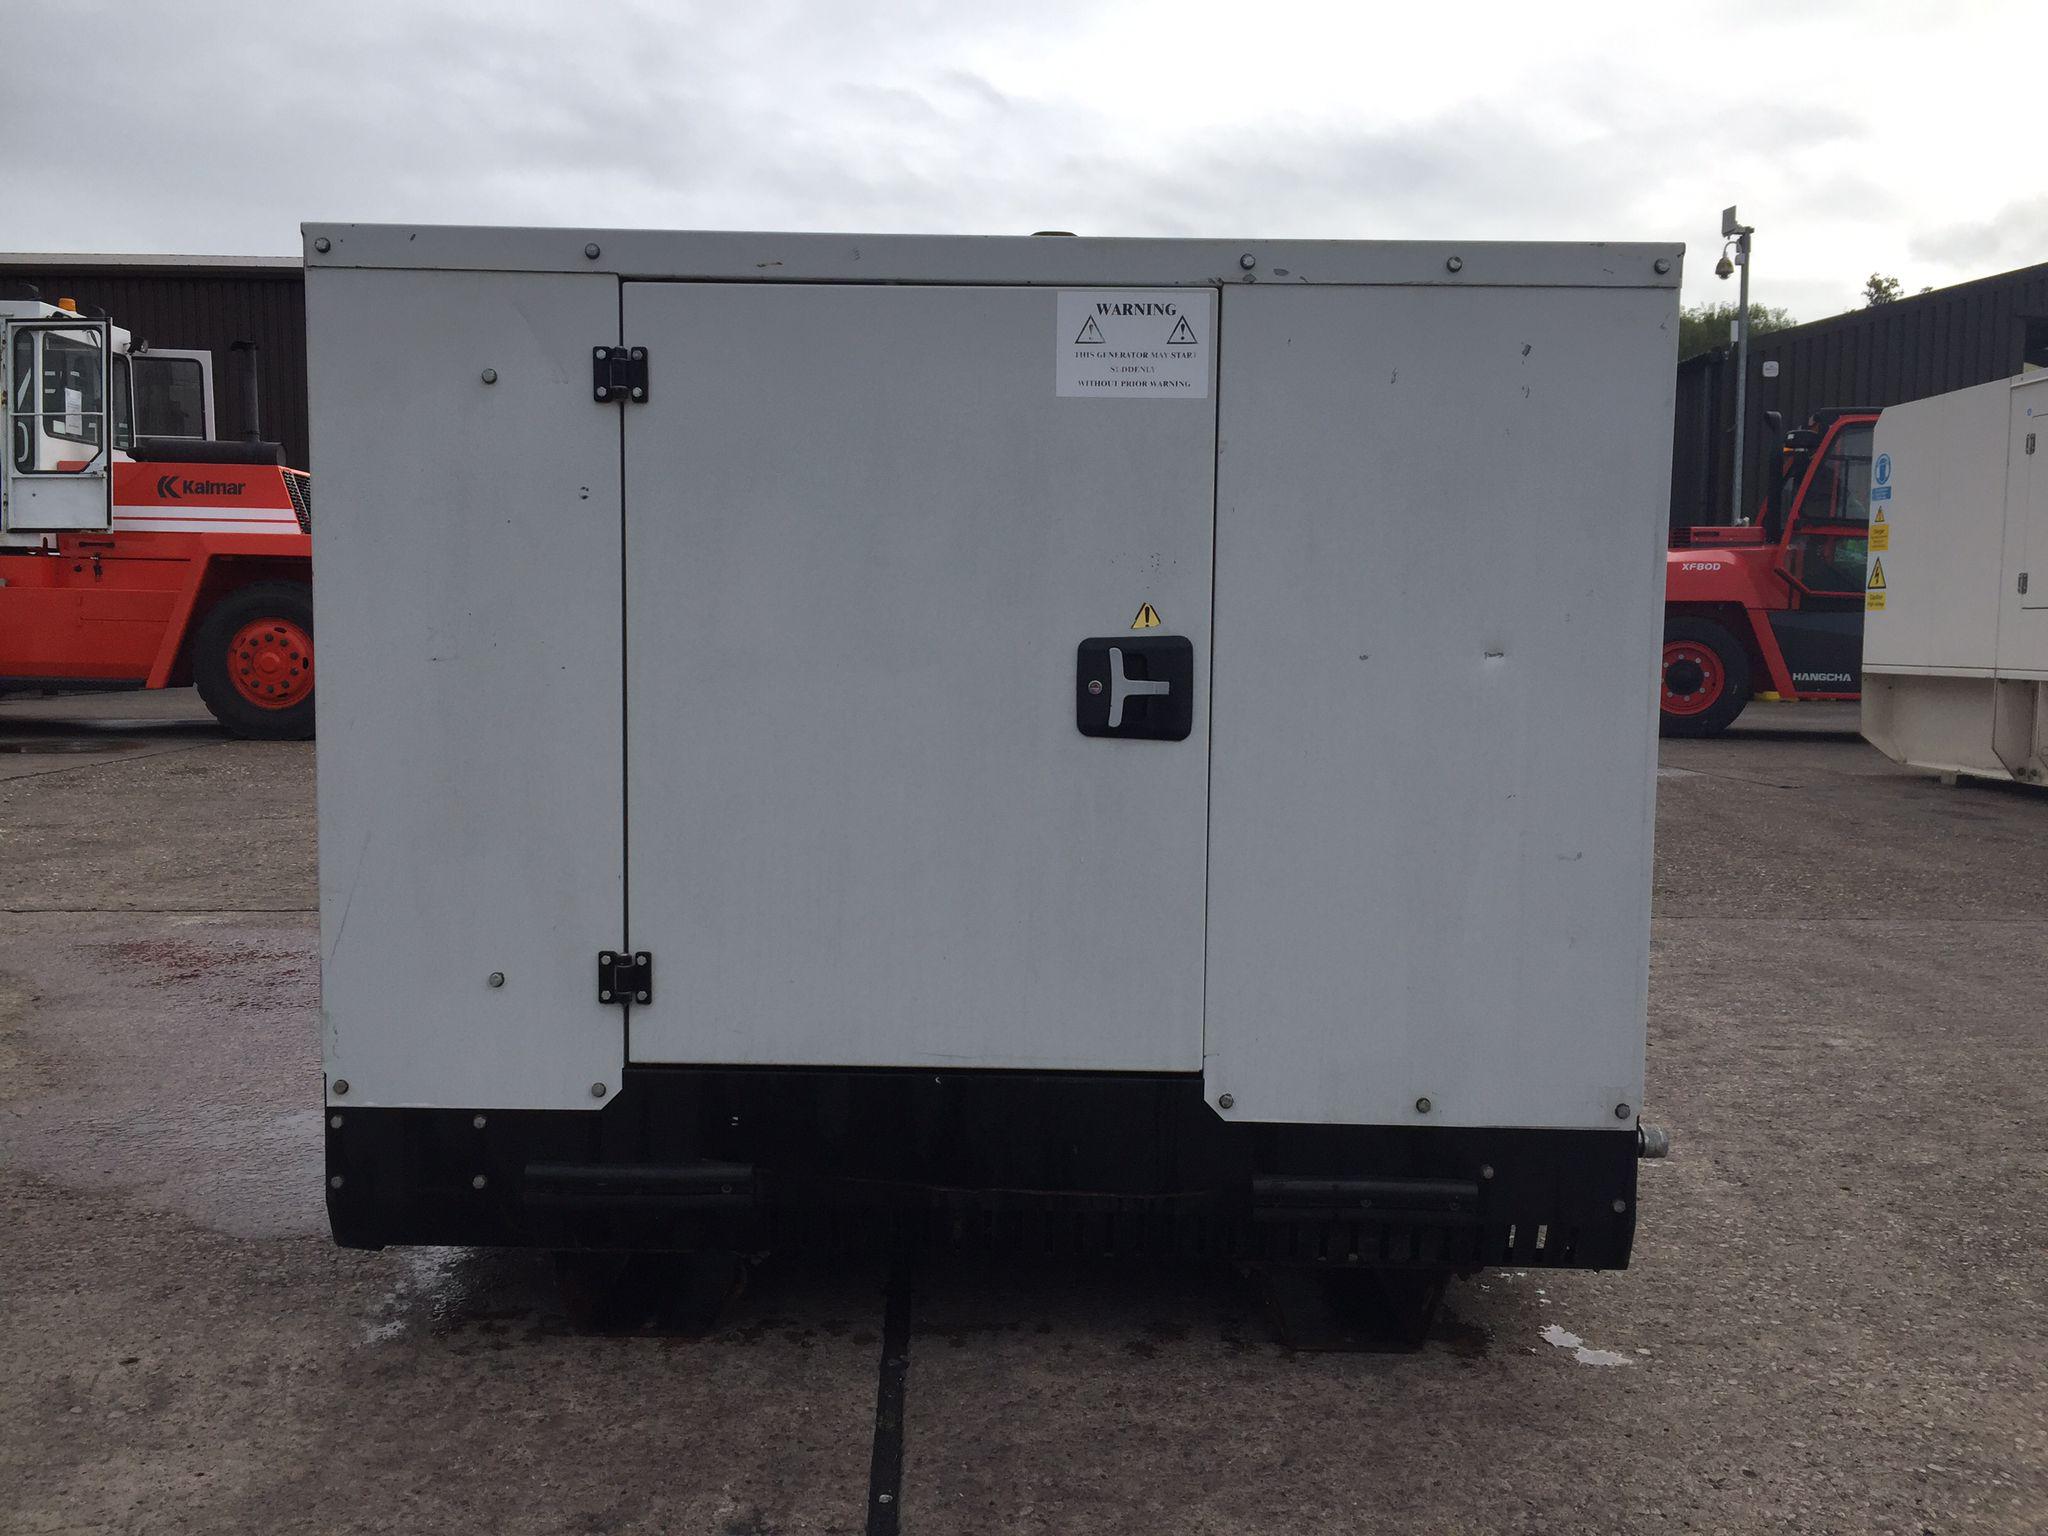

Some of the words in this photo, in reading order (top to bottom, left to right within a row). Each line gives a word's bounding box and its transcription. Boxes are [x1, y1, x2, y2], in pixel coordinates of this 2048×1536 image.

[1096, 303, 1177, 316] WARNING
[1074, 351, 1095, 359] THIS
[1096, 351, 1149, 359] GENERATOR
[1151, 351, 1169, 359] MAY
[182, 480, 246, 496] Kalmar
[1792, 672, 1852, 682] HANGCHA
